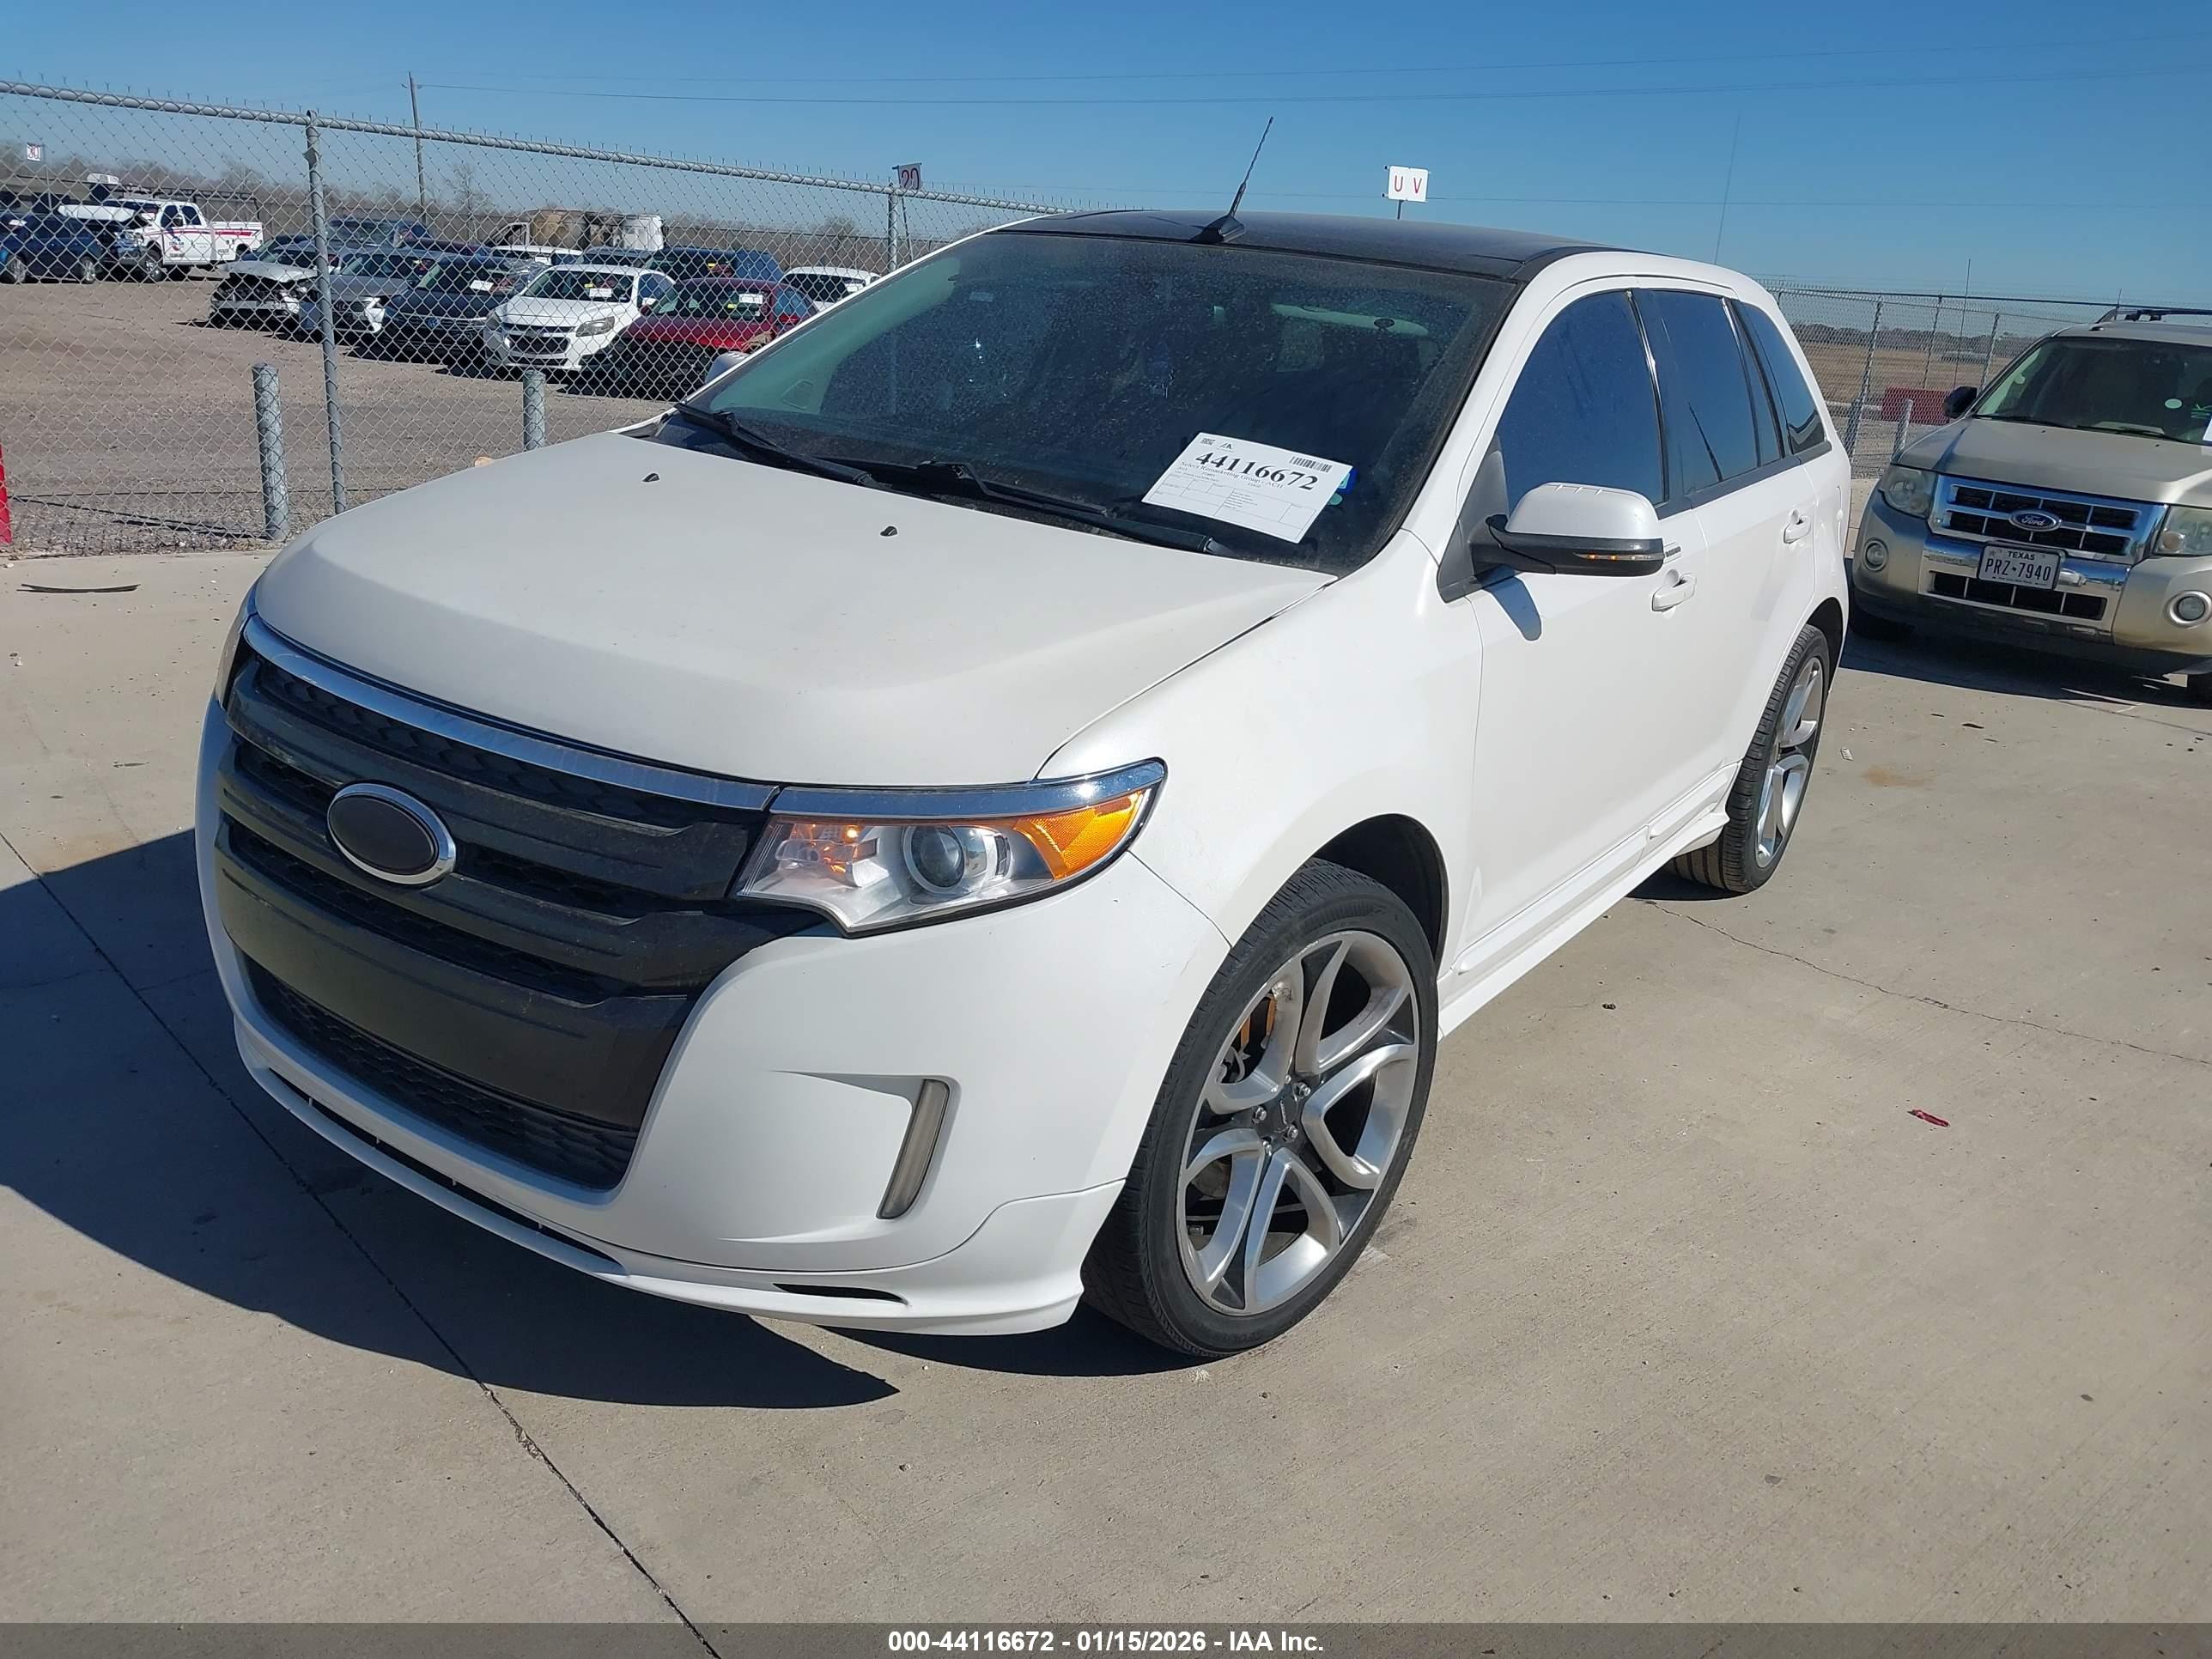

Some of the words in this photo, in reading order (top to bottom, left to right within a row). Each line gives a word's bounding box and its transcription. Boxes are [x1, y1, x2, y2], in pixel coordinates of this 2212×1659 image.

[1195, 452, 1318, 490] 44116672
[2021, 515, 2046, 526] Ford
[2008, 550, 2035, 561] TEXAS
